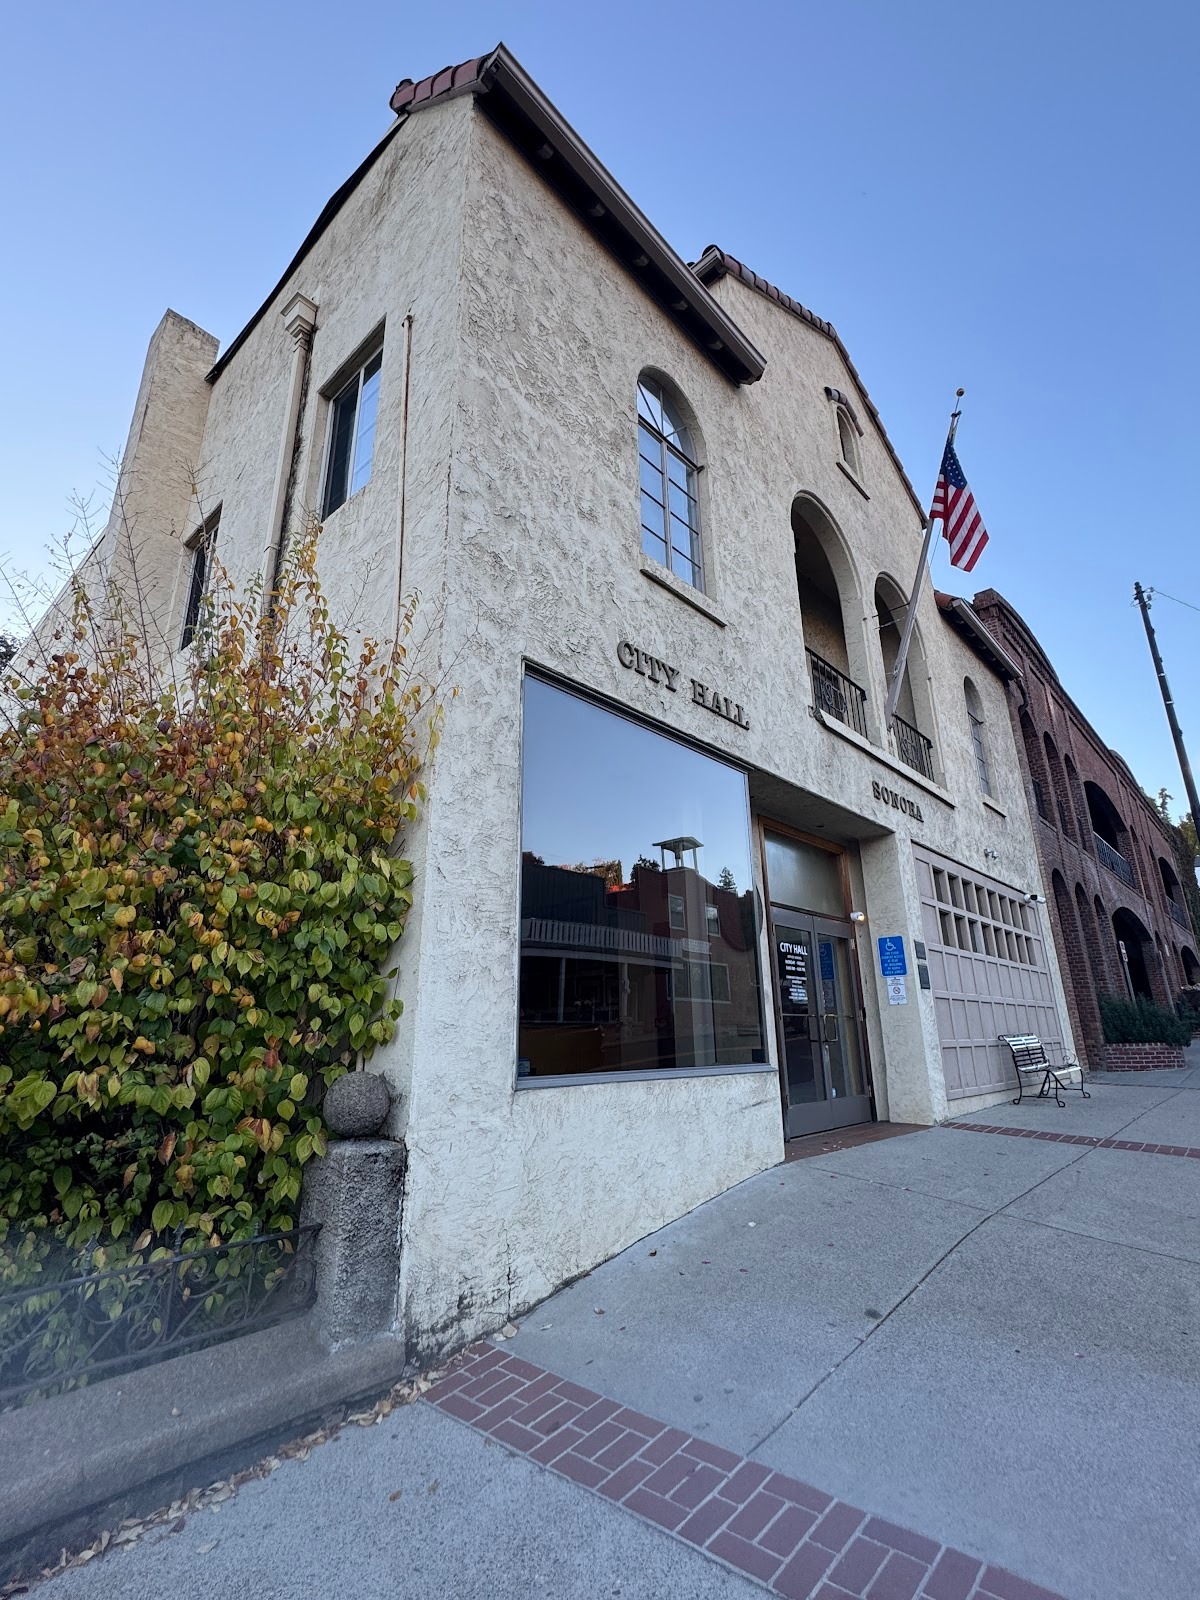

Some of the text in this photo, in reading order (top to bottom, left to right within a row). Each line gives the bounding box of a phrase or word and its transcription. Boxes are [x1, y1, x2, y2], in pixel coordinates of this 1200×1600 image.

[617, 640, 749, 730] CITY HALL
[872, 780, 924, 823] SONORA
[780, 942, 808, 956] CITY HALL
